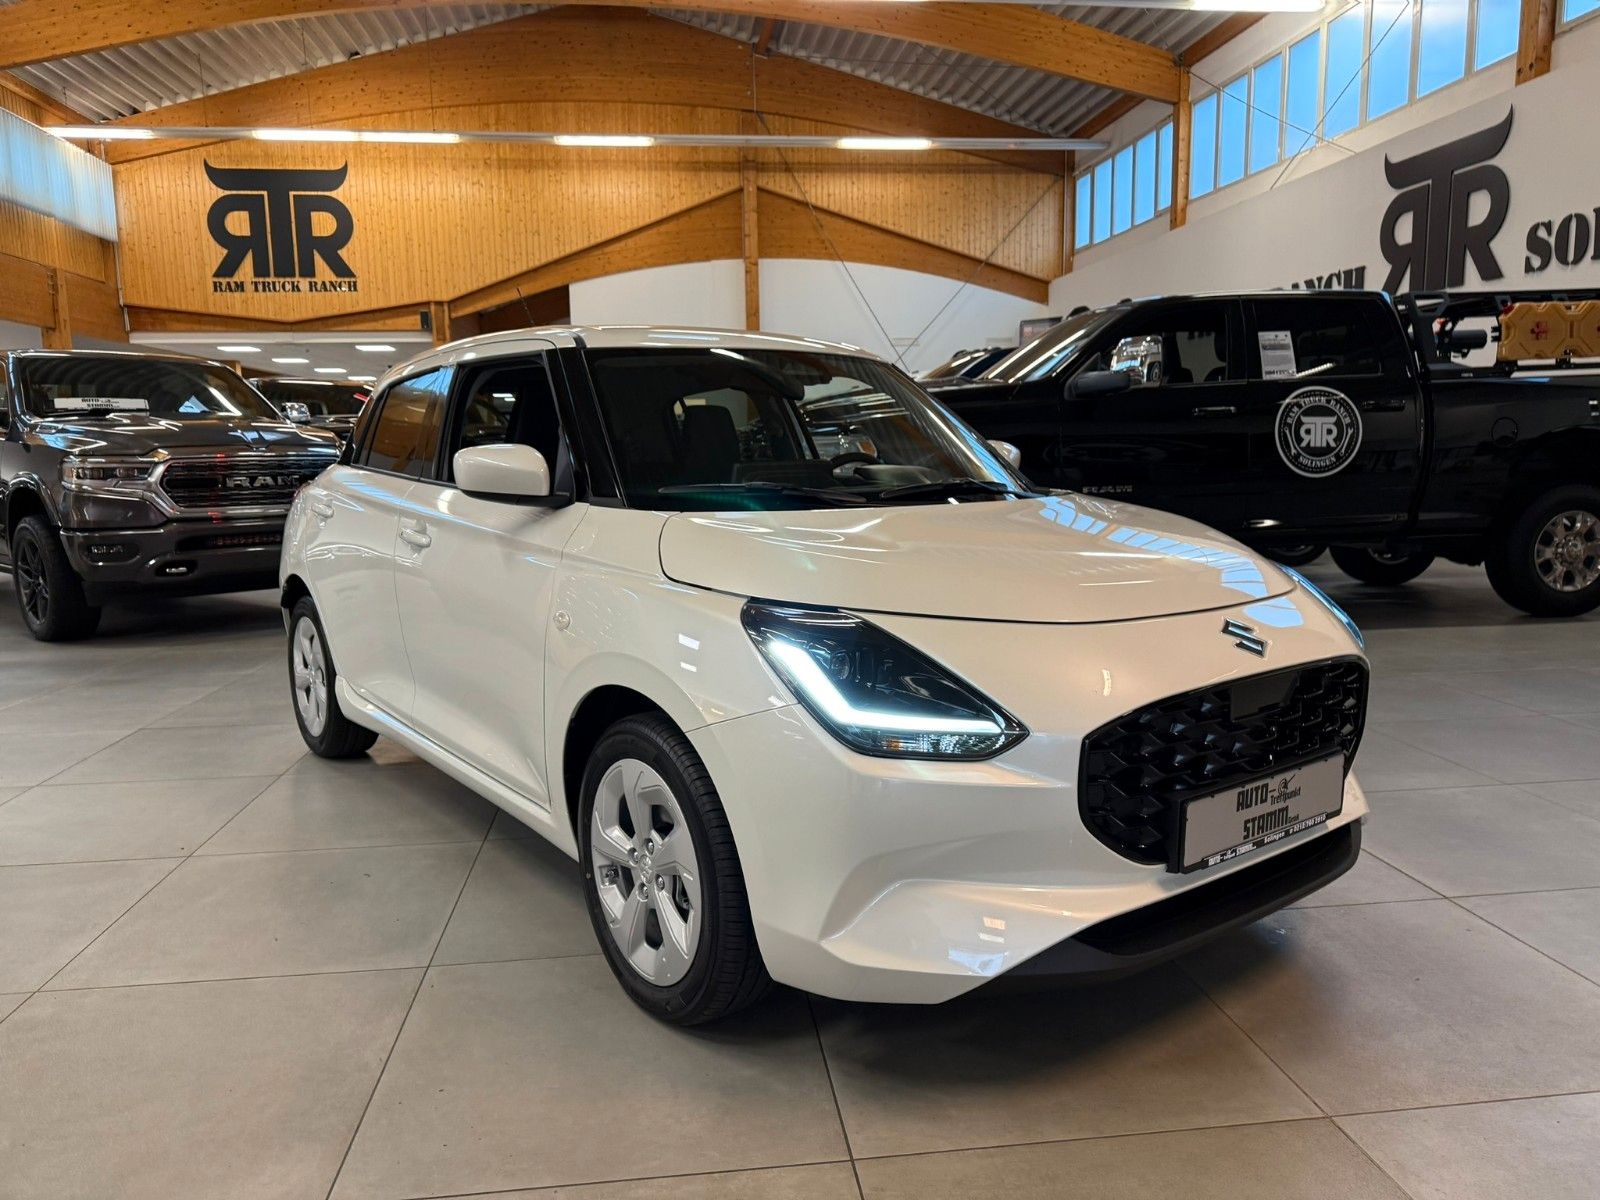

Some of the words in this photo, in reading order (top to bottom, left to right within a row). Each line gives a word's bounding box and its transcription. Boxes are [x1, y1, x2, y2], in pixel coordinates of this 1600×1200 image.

[1524, 207, 1600, 274] SO
[213, 280, 245, 293] RAM
[251, 280, 302, 293] TRUCK
[308, 280, 358, 293] RANCH
[1300, 396, 1327, 407] TRUCK
[1330, 399, 1351, 425] RANCH
[1298, 455, 1337, 468] SOLINGEN
[226, 475, 300, 488] RAM
[1243, 805, 1289, 840] STAMM
